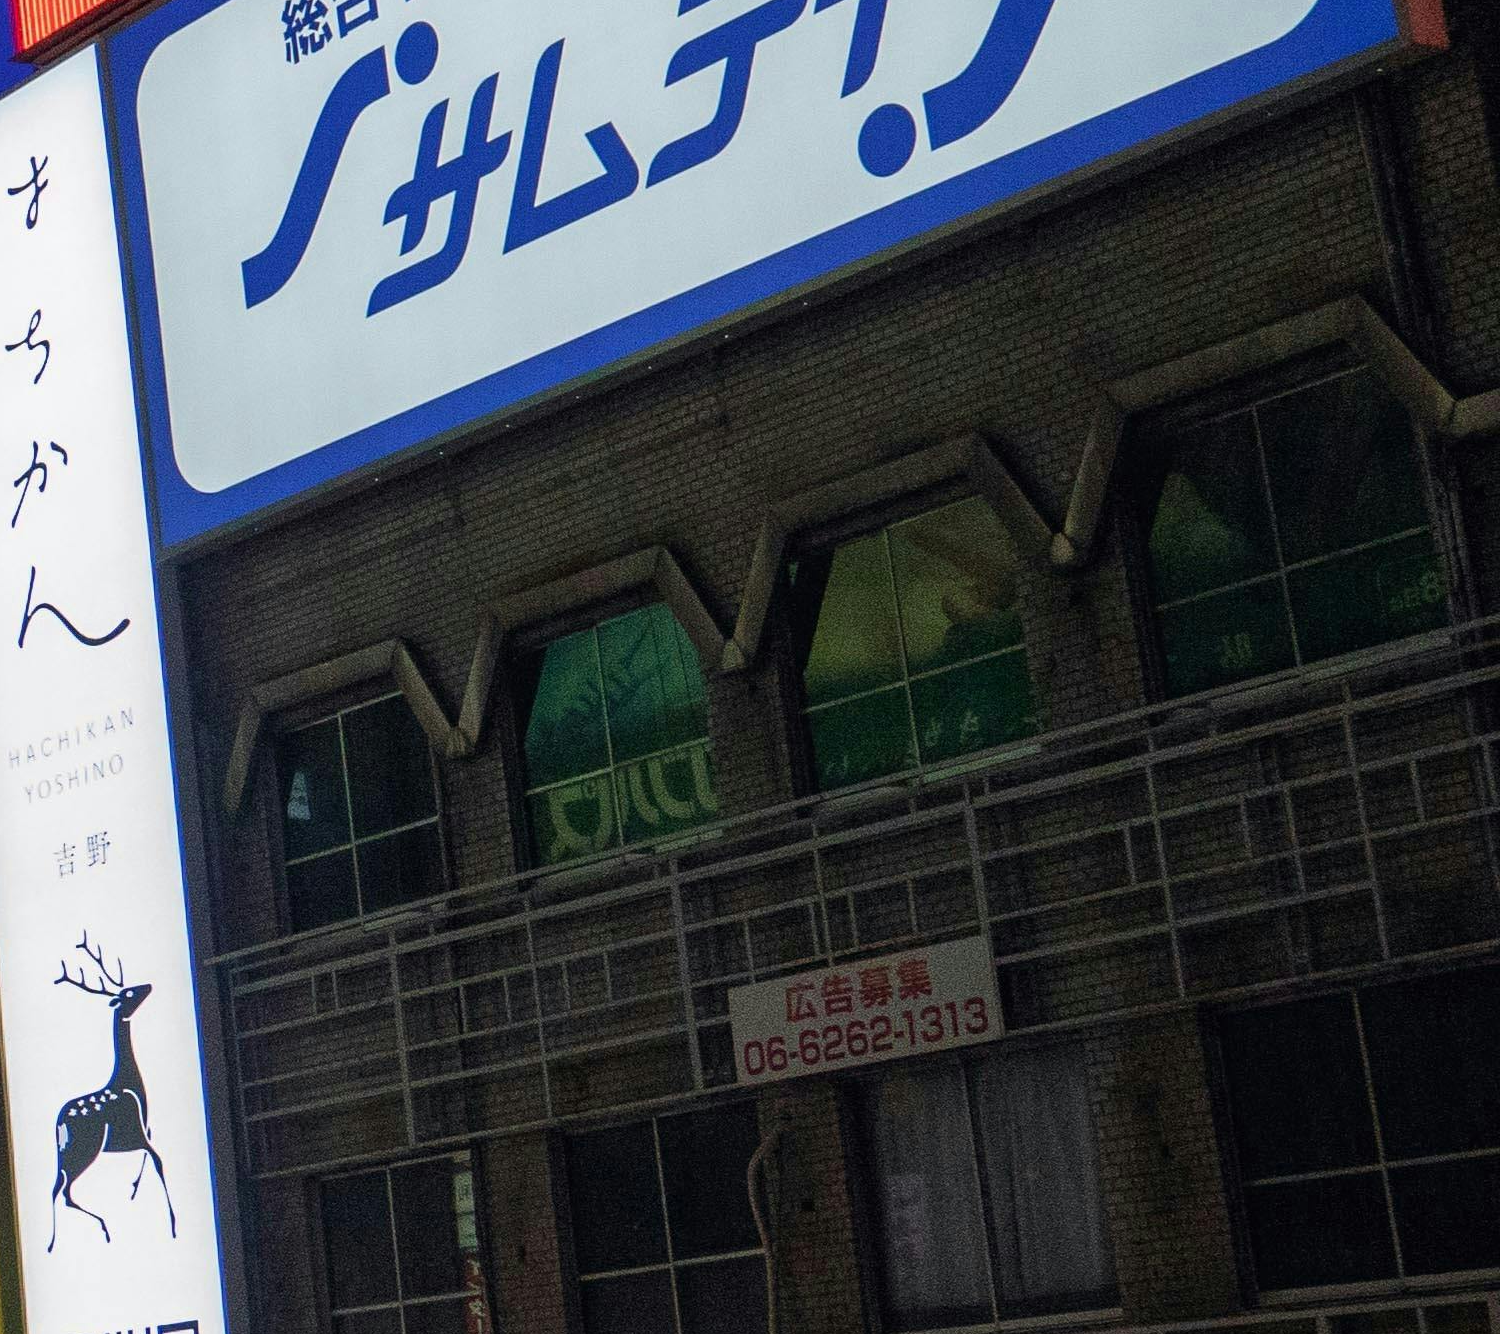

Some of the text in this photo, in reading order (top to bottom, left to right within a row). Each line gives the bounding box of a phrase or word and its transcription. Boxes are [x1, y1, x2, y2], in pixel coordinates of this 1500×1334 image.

[8, 707, 135, 769] HACHIKAN
[24, 754, 124, 803] YOSHINO
[783, 954, 935, 1022] 広告募集
[742, 998, 993, 1078] 06-6262-1313
